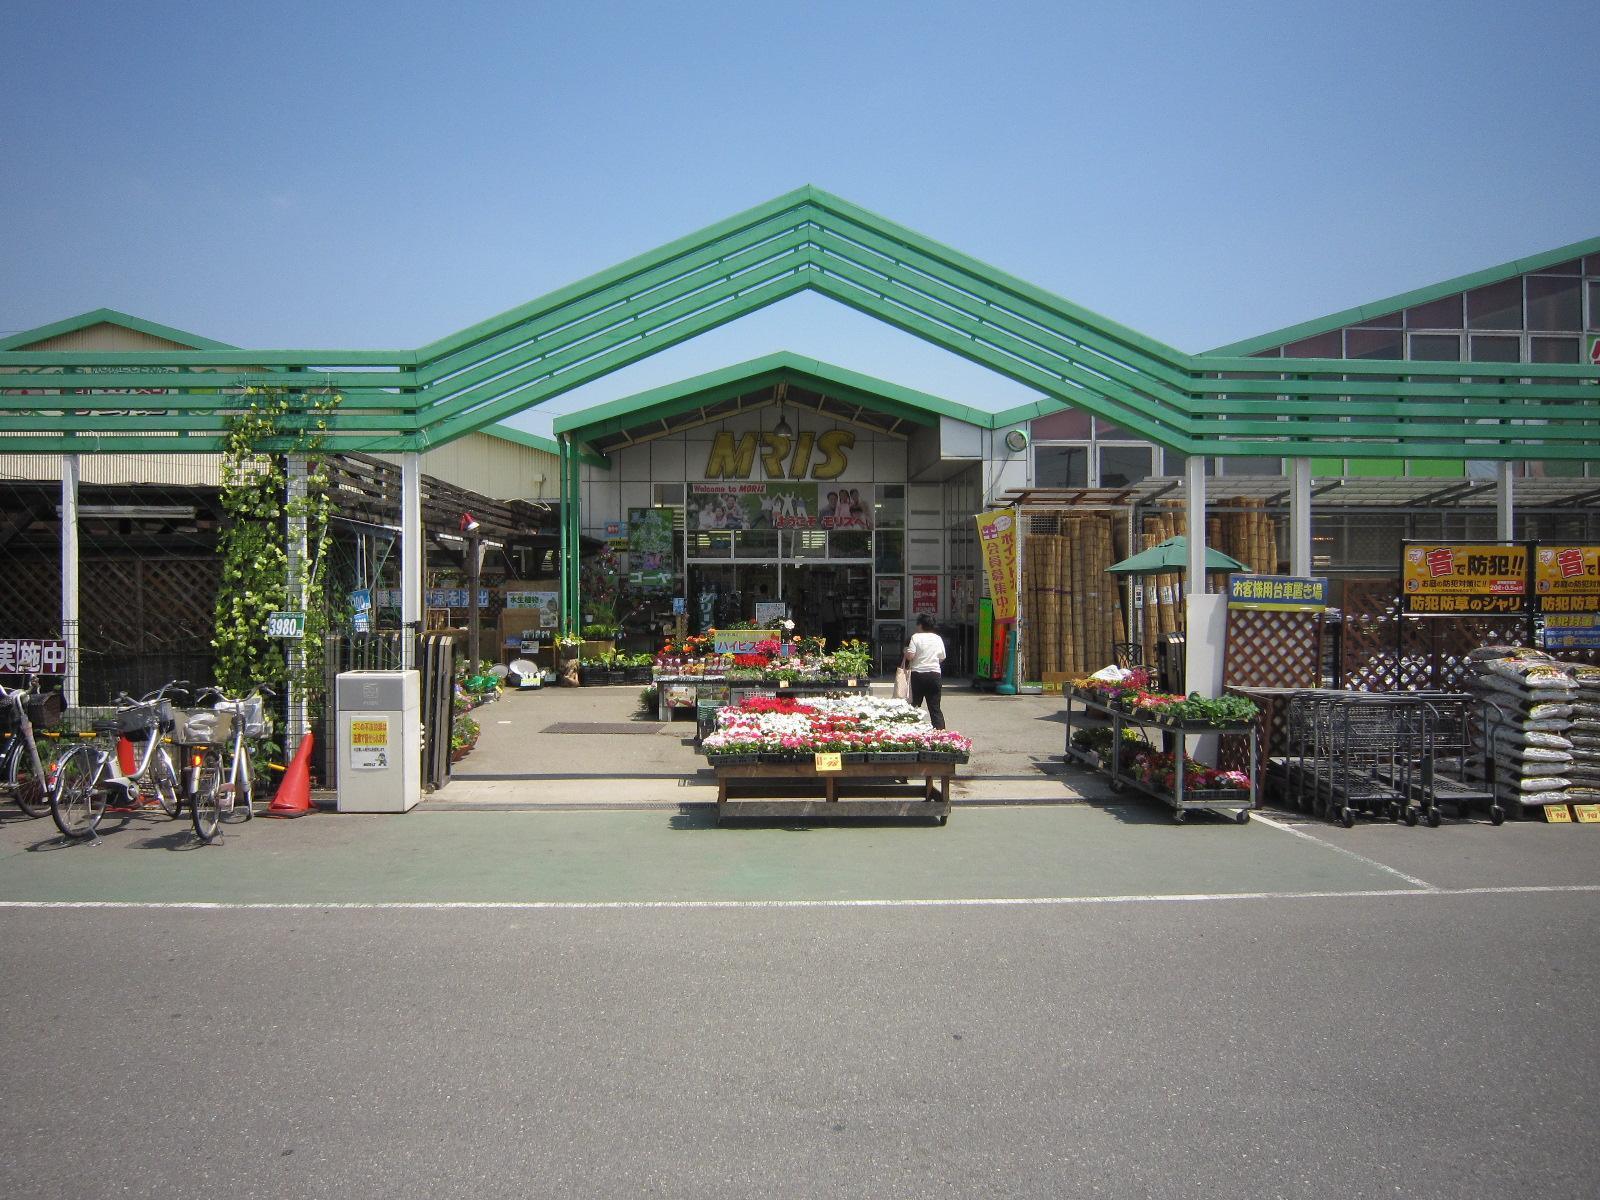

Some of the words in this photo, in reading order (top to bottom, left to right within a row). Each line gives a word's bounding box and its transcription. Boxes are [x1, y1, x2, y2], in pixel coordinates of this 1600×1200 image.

[693, 484, 725, 493] Welcome
[728, 485, 737, 493] to
[738, 483, 766, 493] MORIS
[1233, 580, 1323, 600] お客様用台車置き場
[1410, 596, 1520, 611] 防犯防草のジャリ
